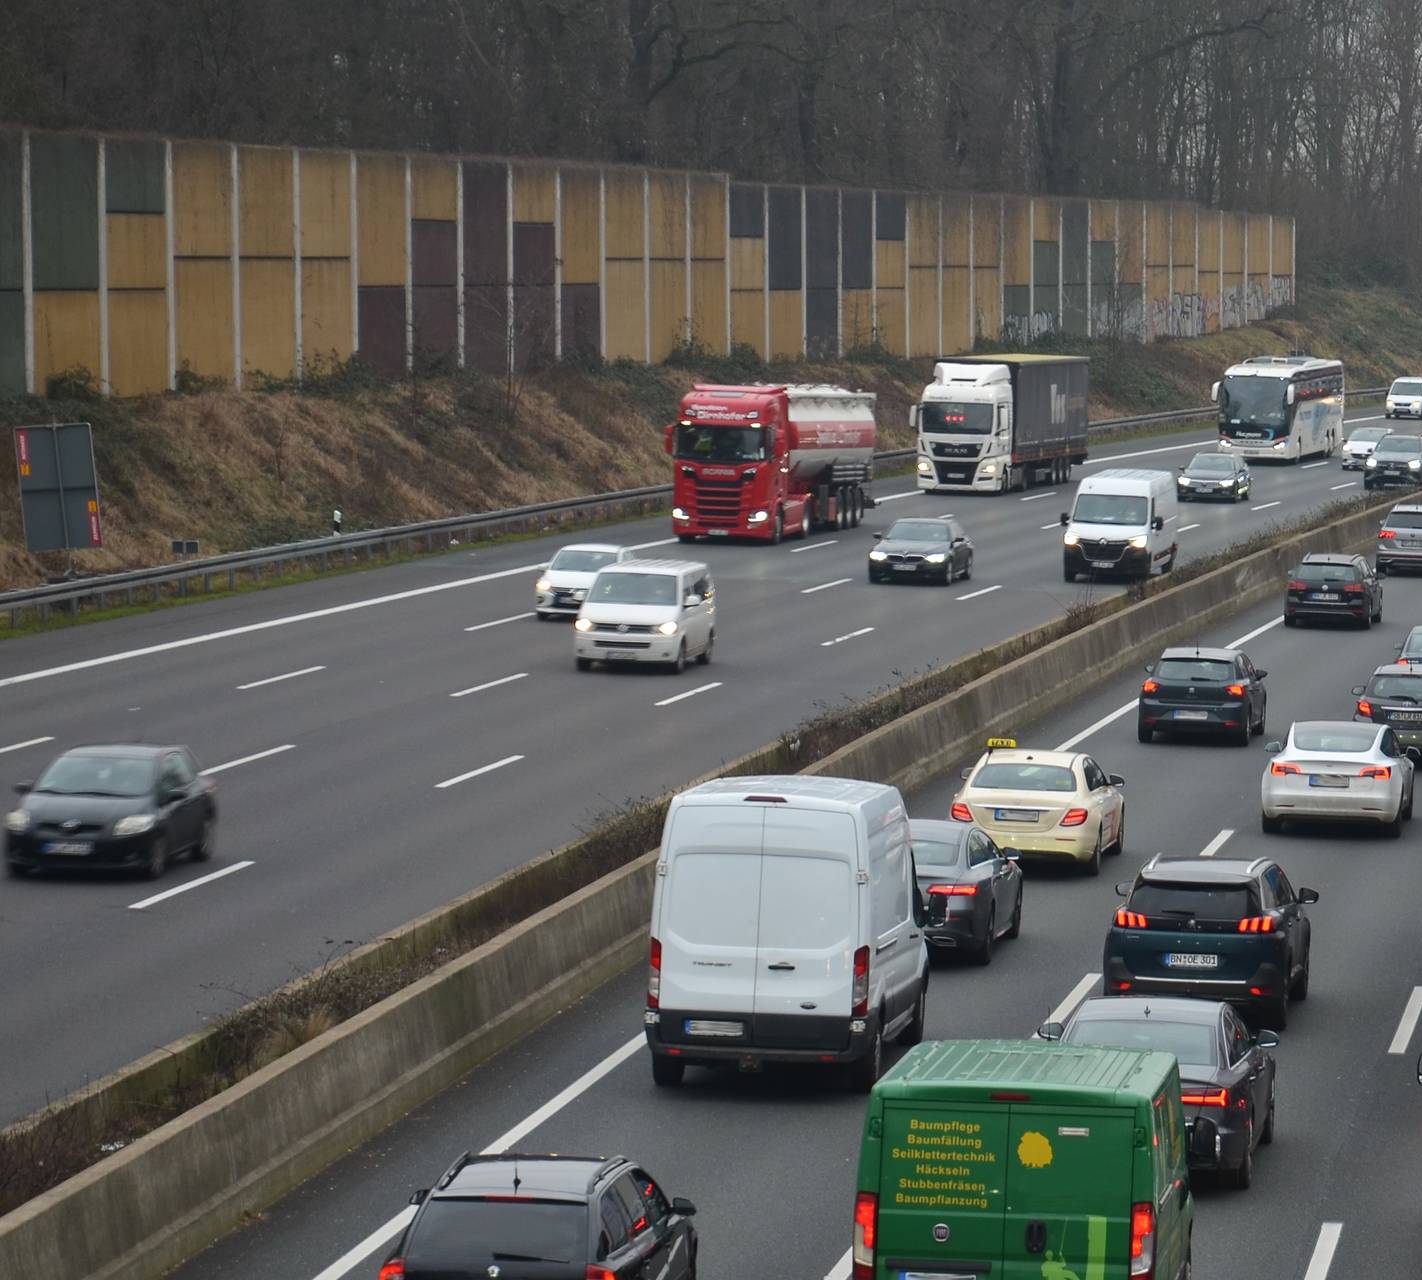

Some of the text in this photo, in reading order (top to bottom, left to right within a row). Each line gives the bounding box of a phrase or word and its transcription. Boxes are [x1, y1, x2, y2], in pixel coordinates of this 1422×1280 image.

[910, 1119, 981, 1134] Baumpflege
[906, 1134, 983, 1149] Baumfällung
[891, 1148, 996, 1162] Seilklettertechnik
[915, 1163, 971, 1176] Häckseln
[898, 1178, 986, 1191] Stubbenfräsen
[895, 1192, 988, 1209] Baumpflanzung
